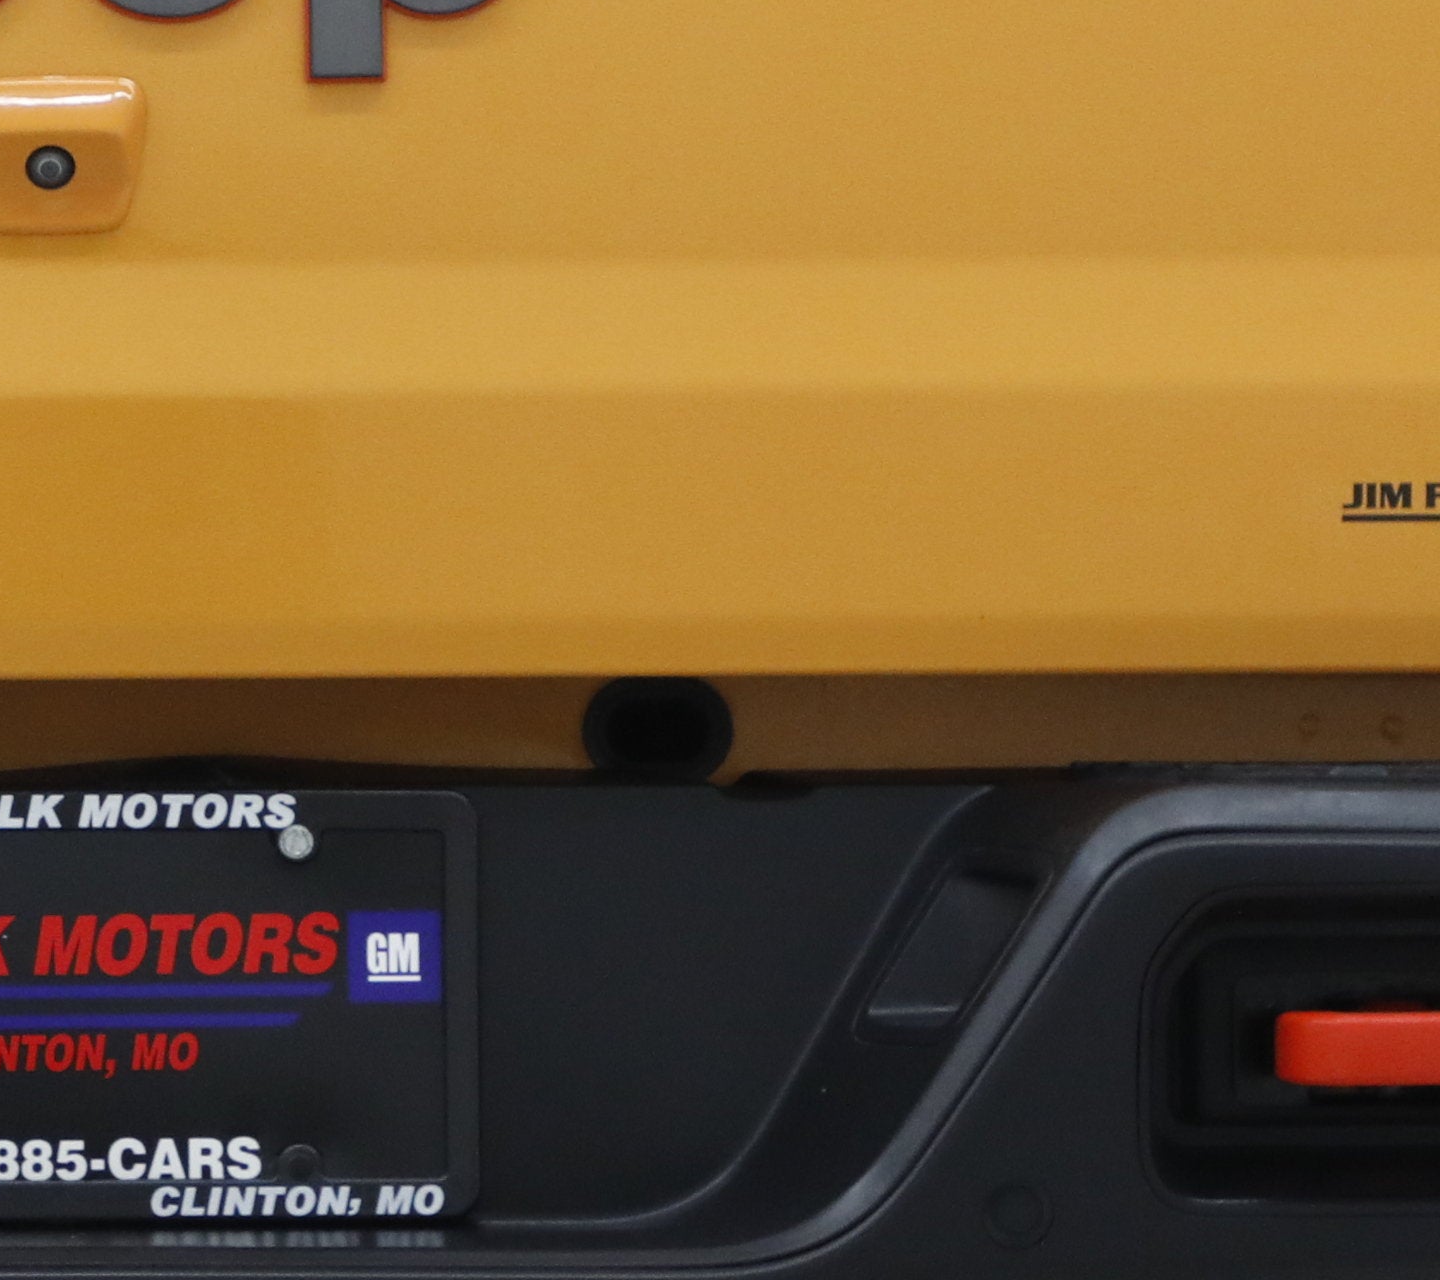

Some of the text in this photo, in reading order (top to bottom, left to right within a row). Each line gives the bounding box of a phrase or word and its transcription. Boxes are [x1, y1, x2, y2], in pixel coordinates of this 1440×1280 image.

[1342, 482, 1413, 509] JIM
[78, 793, 297, 829] MOTORS
[33, 910, 340, 976] MOTORS
[365, 932, 421, 975] GM
[131, 1032, 199, 1071] MO
[150, 1184, 444, 1218] CLINTON, MO
